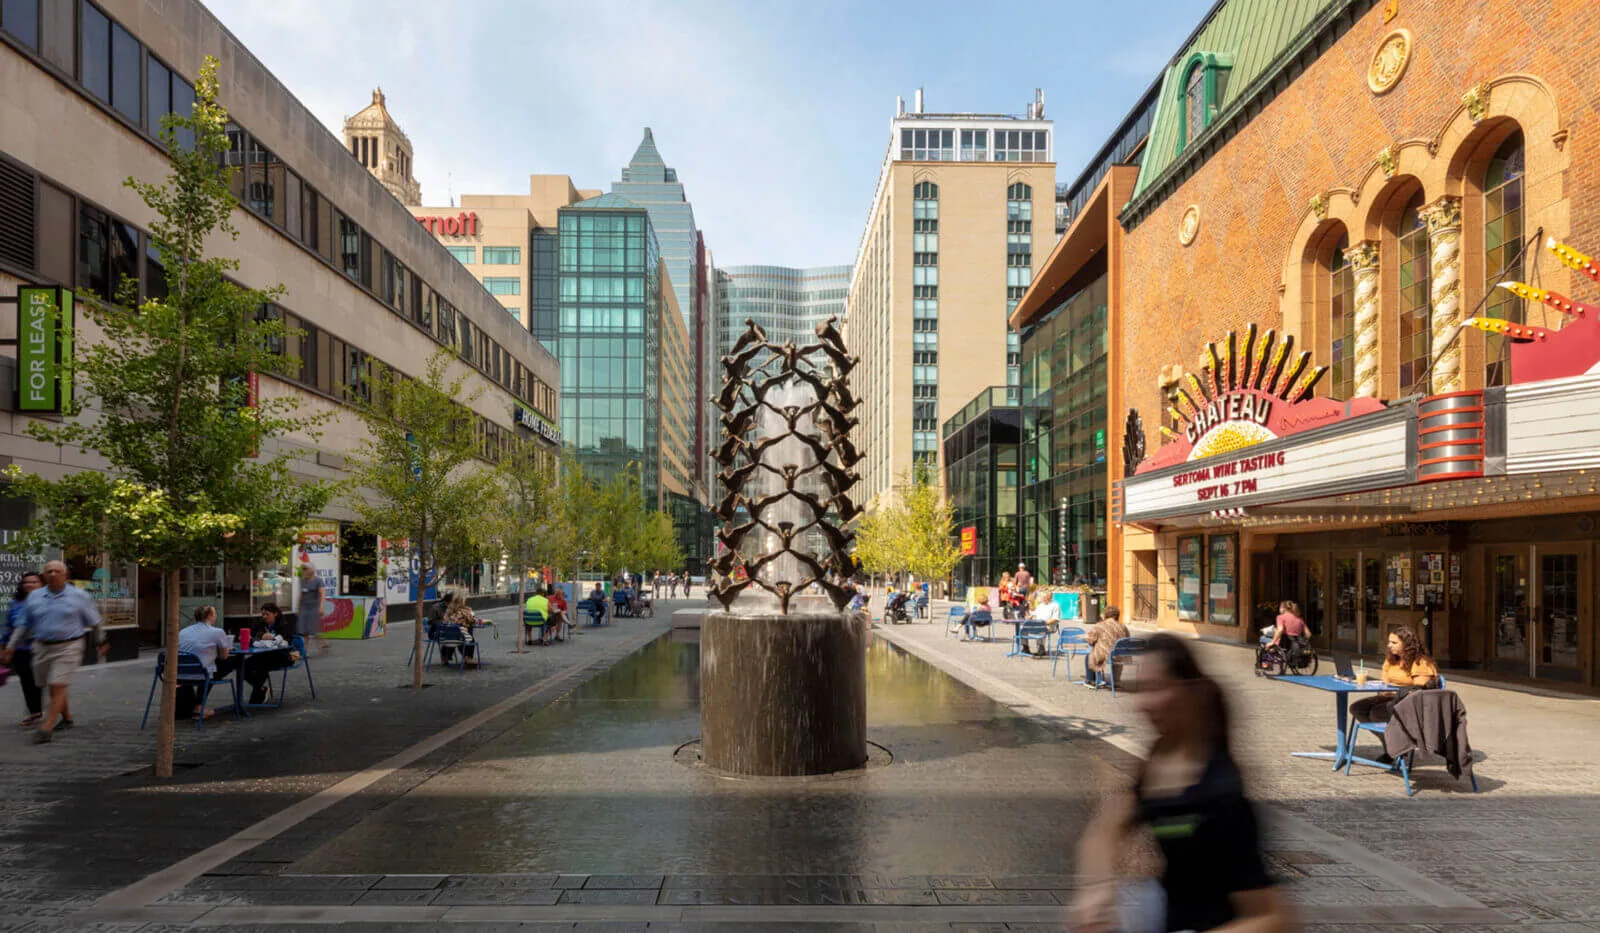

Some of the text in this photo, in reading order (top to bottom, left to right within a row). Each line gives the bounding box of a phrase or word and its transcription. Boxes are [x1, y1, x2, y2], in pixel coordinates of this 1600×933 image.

[30, 293, 46, 401] FOR LEASE
[522, 408, 540, 433] HOME
[1186, 392, 1272, 443] CHATEAU
[1173, 450, 1286, 488] SERTOMA WINE TASTING
[1197, 484, 1218, 501] SEPT
[1220, 483, 1229, 497] 16
